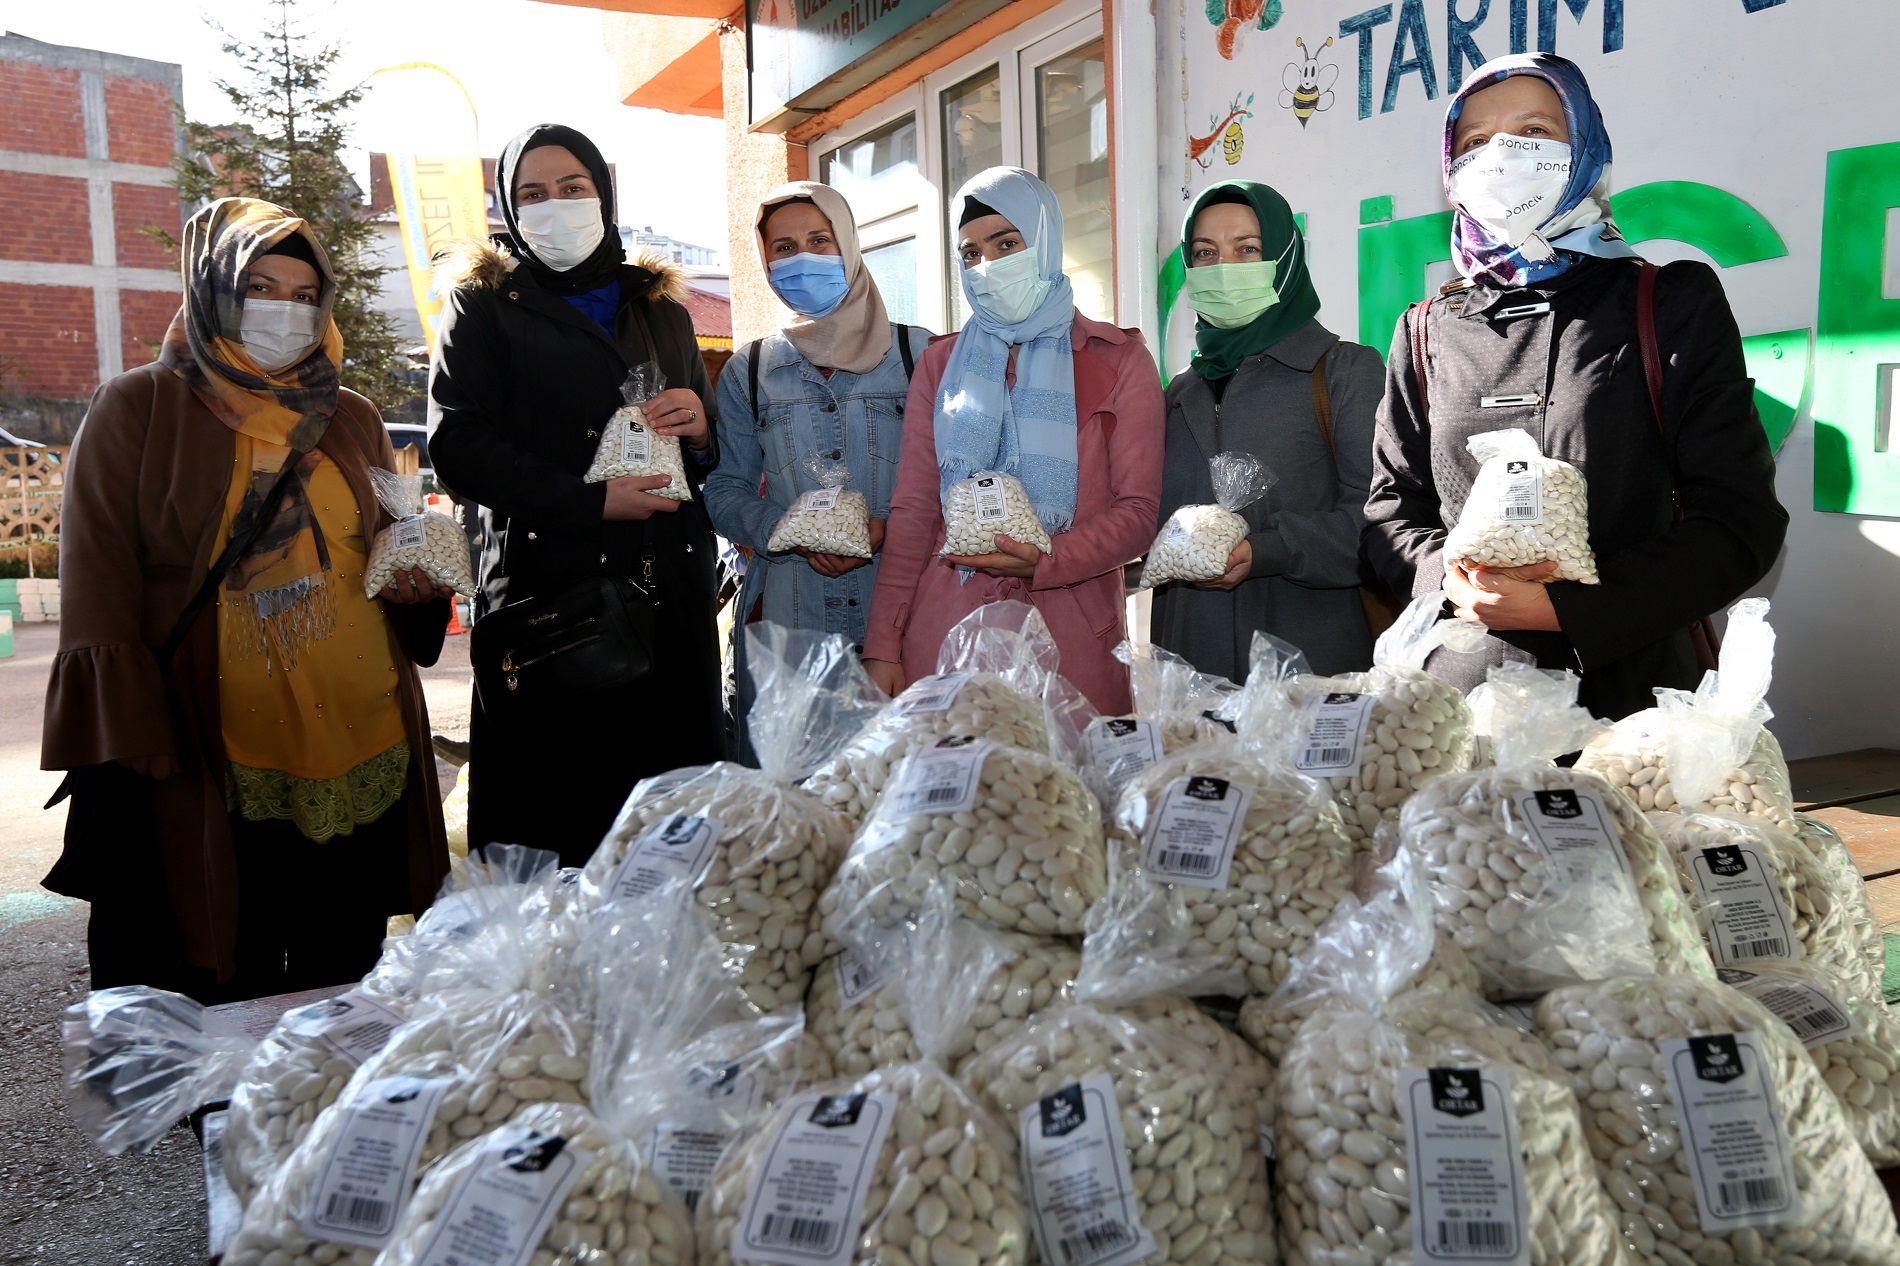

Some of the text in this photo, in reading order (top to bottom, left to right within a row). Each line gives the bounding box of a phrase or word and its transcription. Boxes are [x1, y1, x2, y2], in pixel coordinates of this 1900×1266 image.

[1339, 0, 1624, 120] TARIM
[1498, 138, 1541, 151] poncik
[1505, 194, 1545, 220] poncik
[1714, 864, 1743, 873] ORTAR
